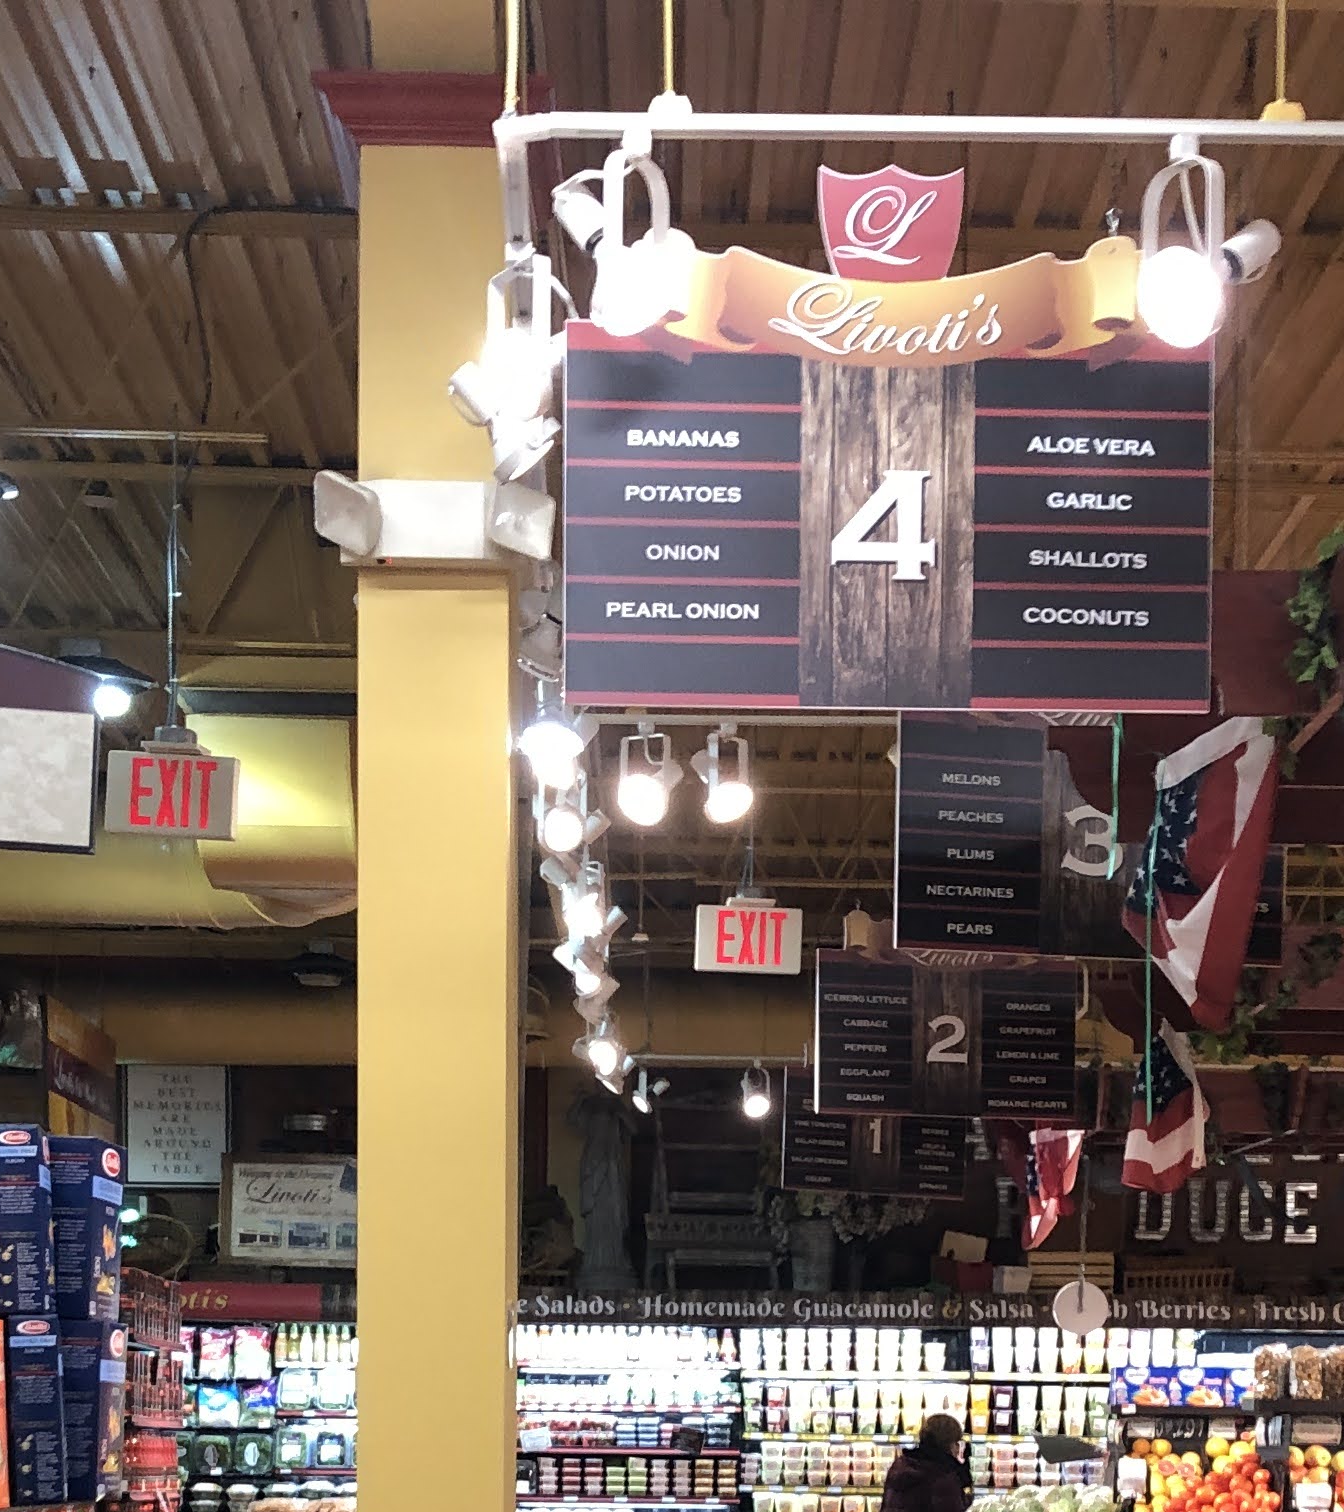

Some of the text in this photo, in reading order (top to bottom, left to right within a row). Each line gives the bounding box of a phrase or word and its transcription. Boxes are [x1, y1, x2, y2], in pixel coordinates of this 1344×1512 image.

[768, 284, 1003, 356] Livoti's
[626, 429, 740, 449] BANANAS
[1027, 435, 1156, 458] ALOE VERA
[624, 484, 742, 504] POTATOES
[1046, 491, 1133, 512] GARLIC
[830, 469, 937, 582] 4
[645, 543, 721, 562] ONION
[1028, 548, 1148, 570] SHALLOTS
[605, 600, 761, 621] PEARL ONION
[1023, 606, 1150, 627] COCONUTS
[942, 773, 1001, 786] MELONS
[129, 758, 217, 829] EXIT
[938, 810, 1004, 824] PEACHES
[1061, 804, 1124, 877] 3
[947, 848, 994, 861] PLUMS
[926, 884, 1014, 898] NECTARINES
[947, 923, 993, 935] PEARS
[717, 909, 787, 966] EXIT
[867, 995, 908, 1005] LETTUCE
[1006, 1002, 1051, 1011] ORANGES
[843, 1018, 889, 1028] CABBAGE
[999, 1026, 1057, 1036] GRAPEFRUIT
[926, 1014, 968, 1064] 2
[844, 1043, 887, 1053] PEPPERS
[996, 1051, 1029, 1060] LEMON
[1039, 1052, 1060, 1060] LIME
[840, 1068, 891, 1078] EGGPLANT
[1009, 1075, 1047, 1084] GRAPES
[846, 1093, 884, 1102] SQUASH
[133, 1101, 223, 1112] MEMORIES
[987, 1100, 1068, 1110] ROMAINE HEARTS
[869, 1118, 882, 1154] 1
[144, 1139, 212, 1149] AROUND
[151, 1164, 204, 1174] TABLE
[534, 1293, 616, 1316] Salads
[638, 1294, 785, 1319] Homemade
[794, 1297, 935, 1322] Guacamole
[942, 1298, 962, 1319] &
[969, 1299, 1033, 1321] Salsa
[1135, 1301, 1231, 1322] Berries
[1254, 1302, 1325, 1322] Fresh
